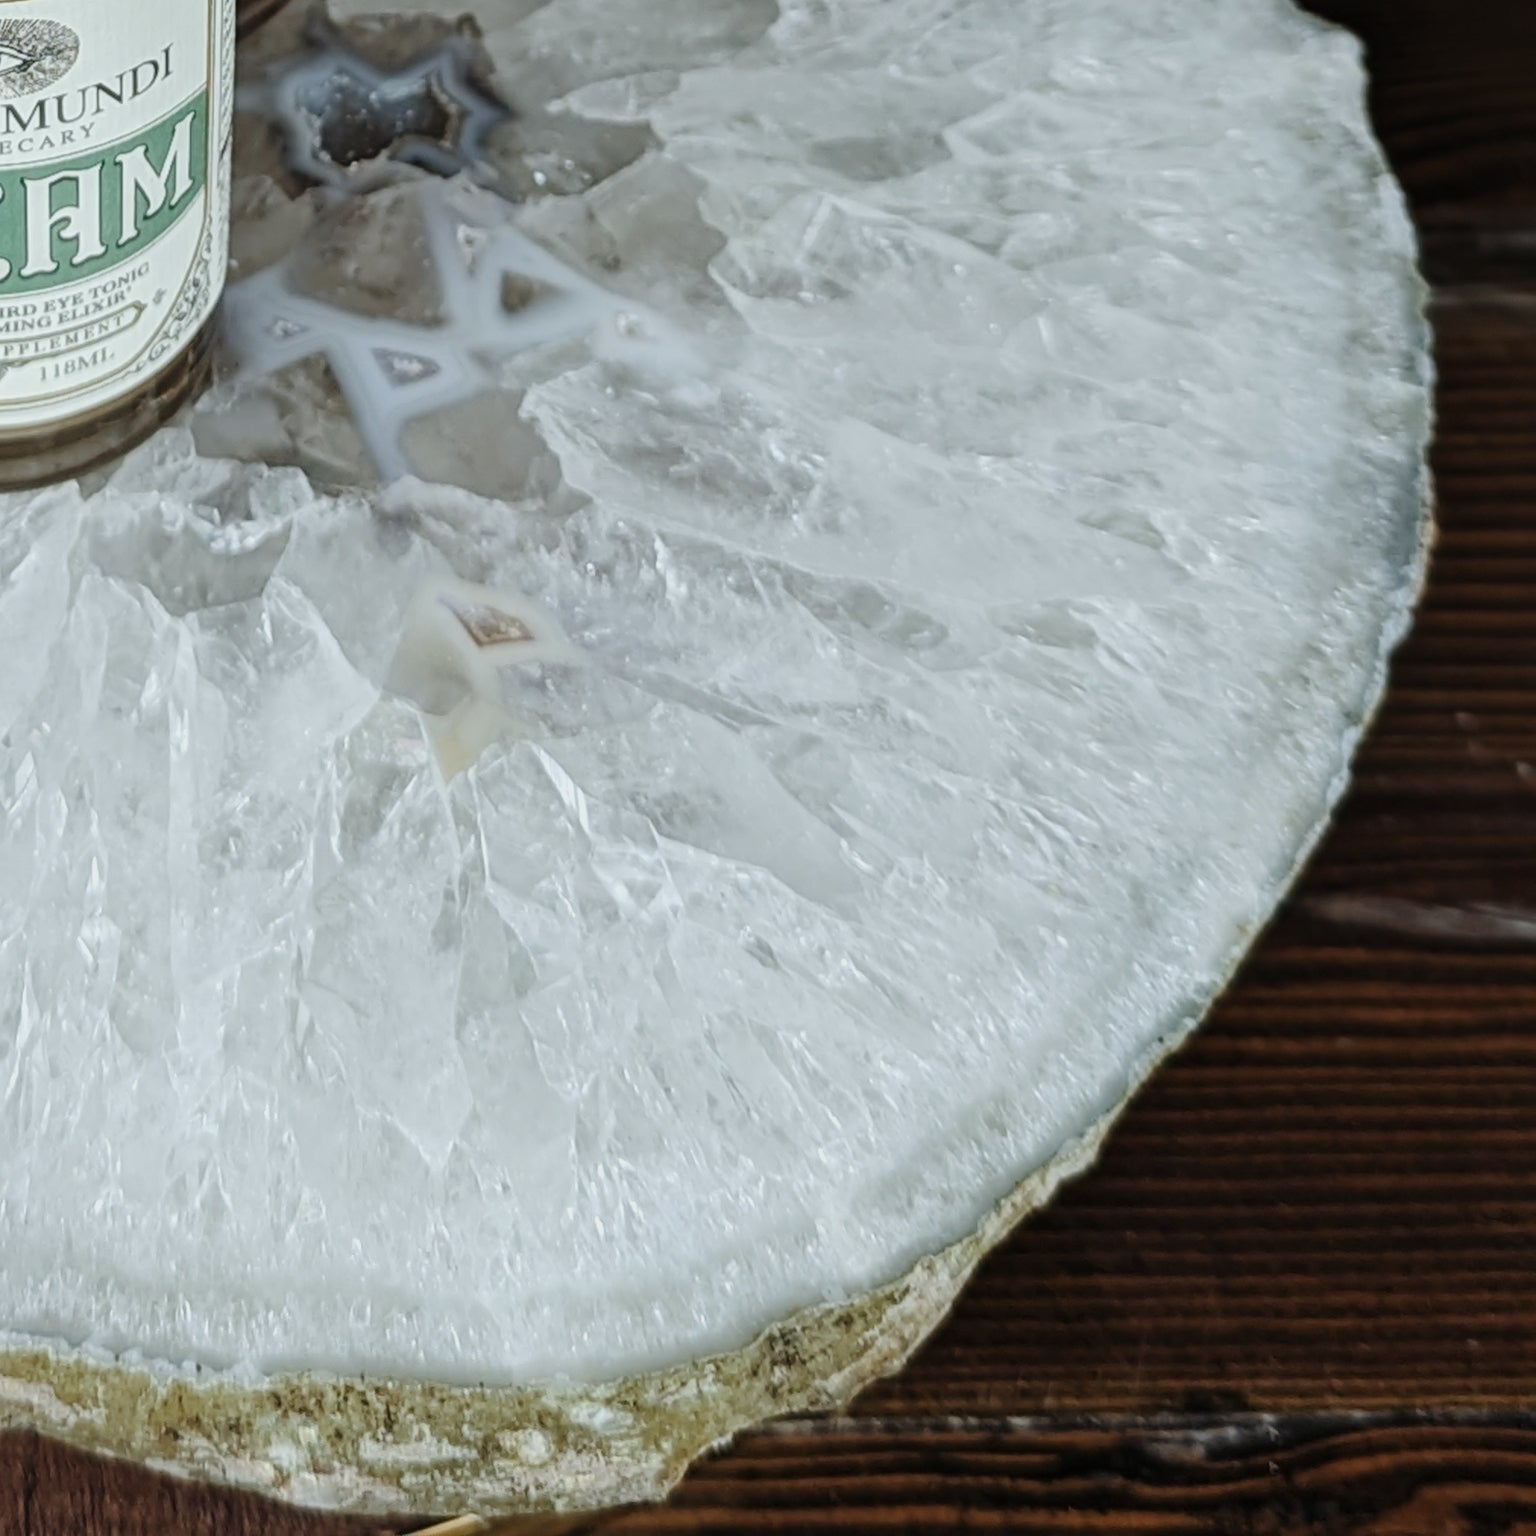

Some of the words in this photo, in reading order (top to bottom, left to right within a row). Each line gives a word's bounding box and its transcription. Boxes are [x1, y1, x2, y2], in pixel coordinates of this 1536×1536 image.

[0, 41, 175, 136] MUNDI
[43, 291, 85, 314] EYE
[88, 260, 151, 300] TONIC
